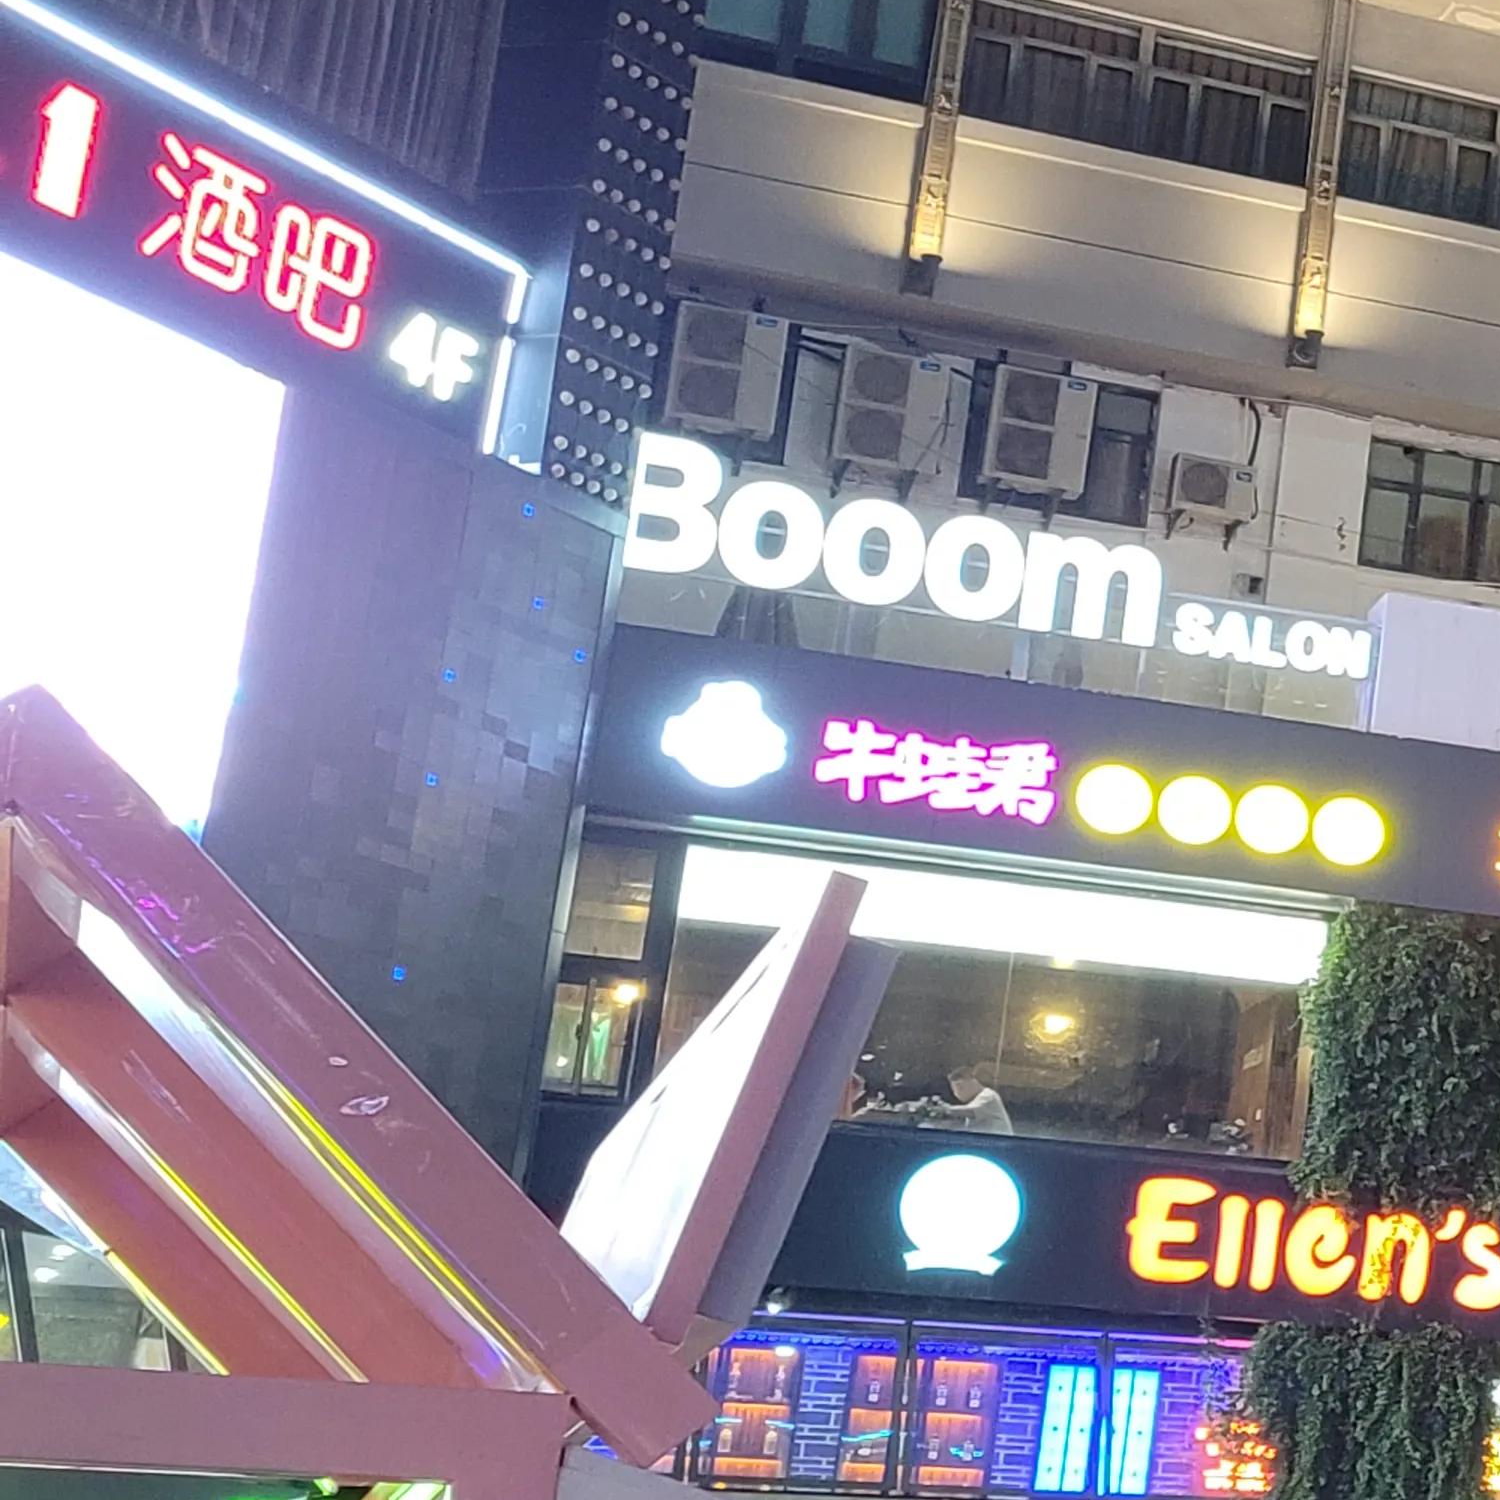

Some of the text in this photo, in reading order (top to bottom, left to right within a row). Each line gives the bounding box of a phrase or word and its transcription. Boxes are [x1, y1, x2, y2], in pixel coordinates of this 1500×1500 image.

[141, 133, 376, 349] 酒吧
[389, 311, 482, 401] 4F
[1173, 602, 1372, 680] SALON
